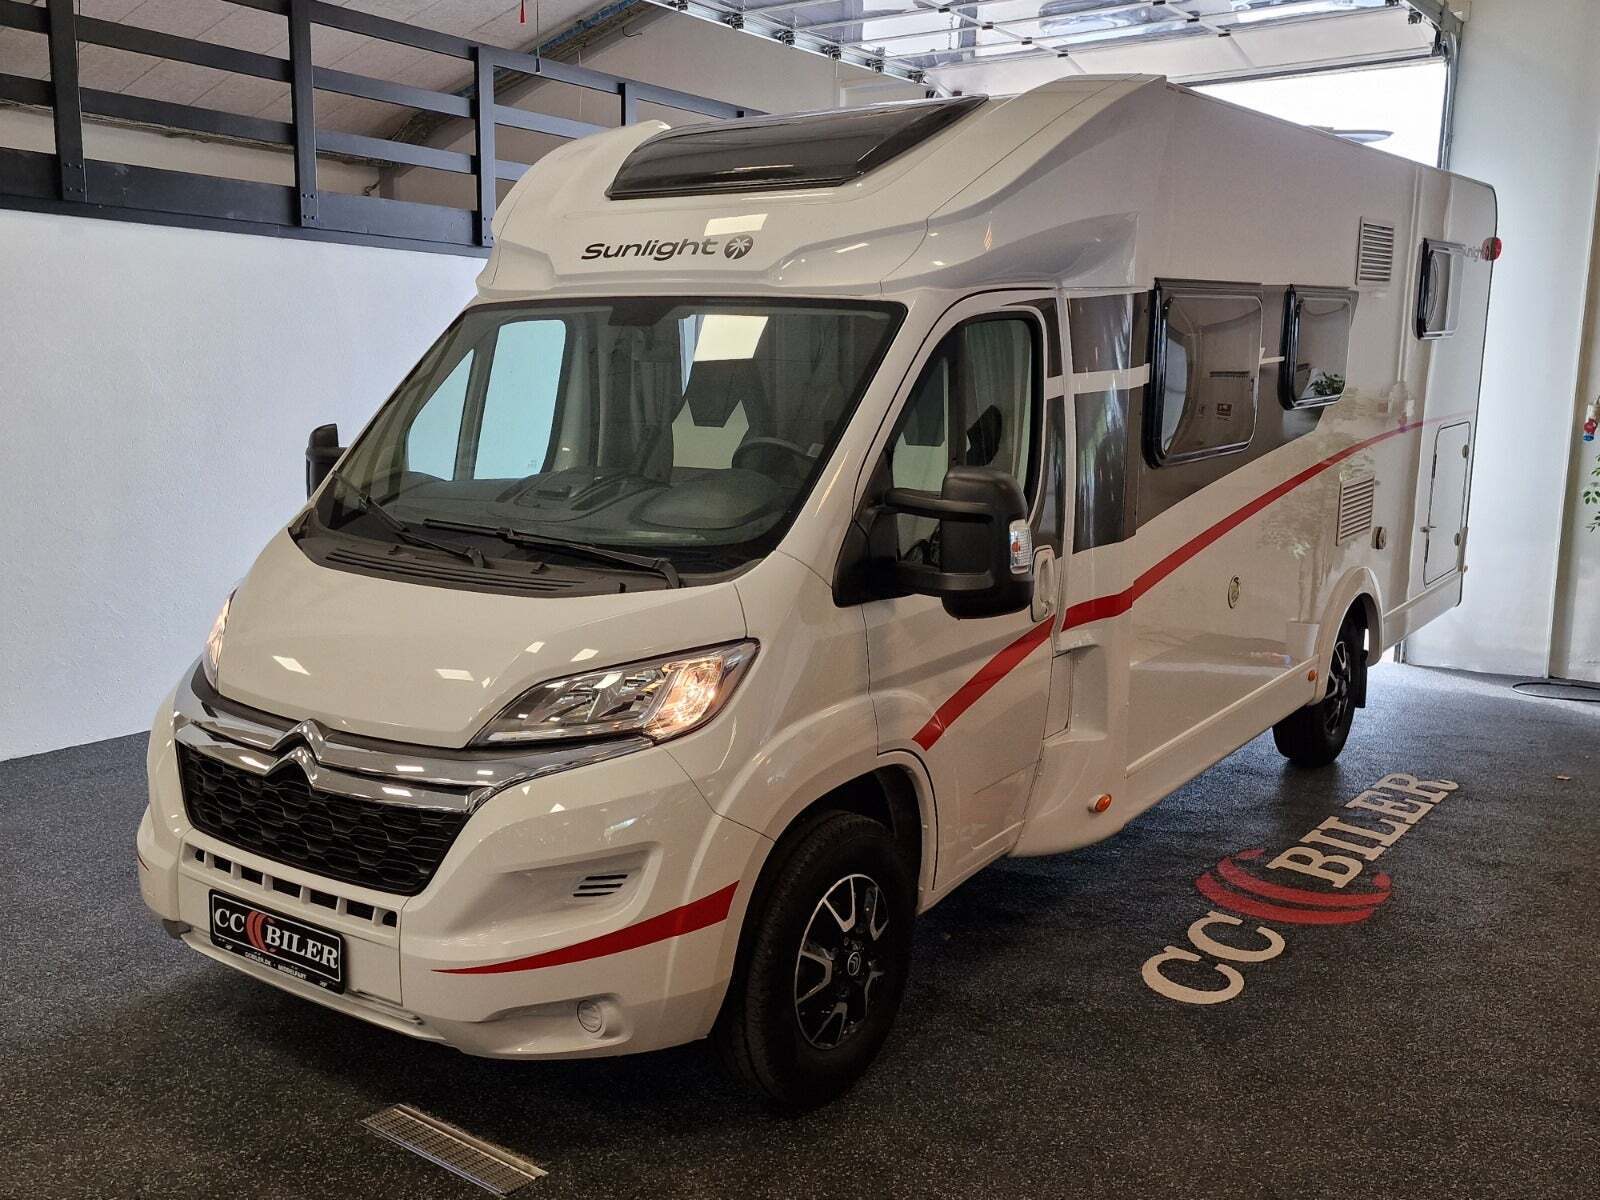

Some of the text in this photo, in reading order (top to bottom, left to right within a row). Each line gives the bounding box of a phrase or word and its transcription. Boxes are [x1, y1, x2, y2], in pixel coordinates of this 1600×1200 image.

[214, 908, 338, 969] CC BILER
[1141, 773, 1458, 1004] CC BILER
